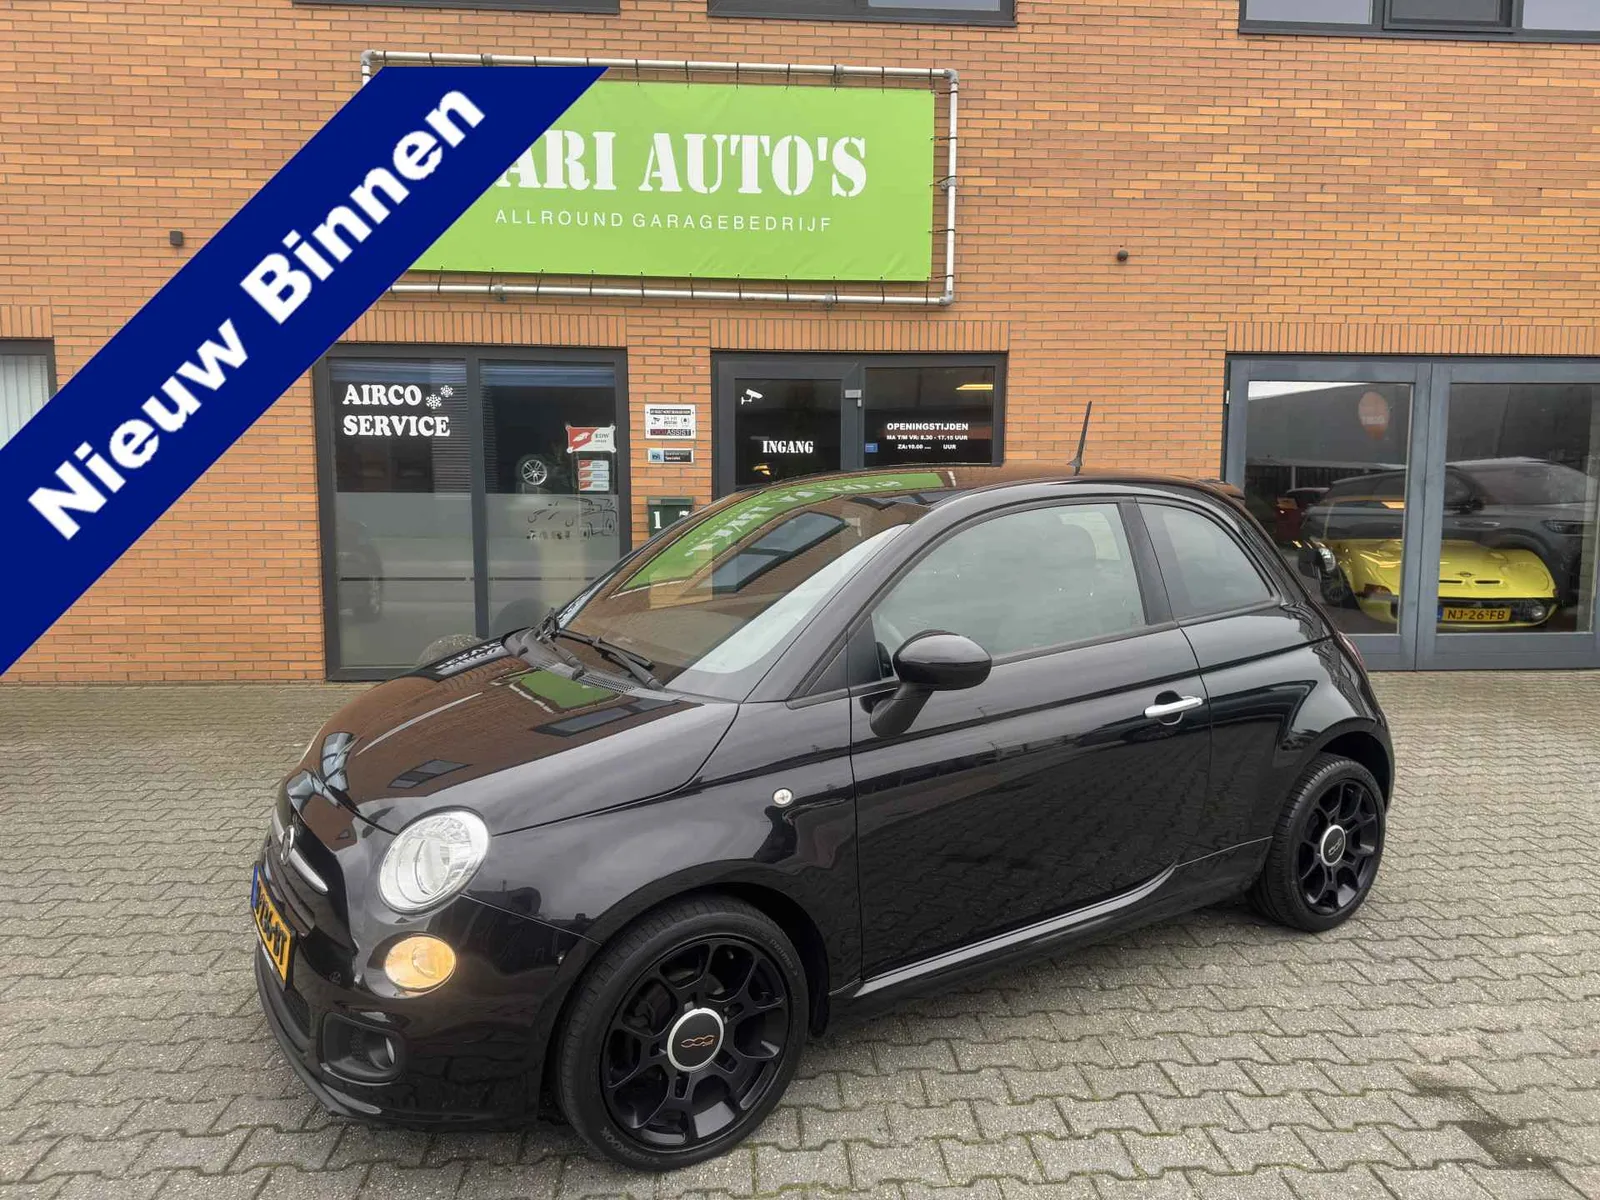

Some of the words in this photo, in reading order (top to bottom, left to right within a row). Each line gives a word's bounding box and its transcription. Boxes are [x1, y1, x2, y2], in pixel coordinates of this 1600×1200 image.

[638, 132, 867, 198] AUTO'S
[495, 209, 623, 228] ALLROUND
[632, 213, 832, 232] GARAGEBEDRIJF
[342, 383, 422, 406] AIRCO
[343, 414, 451, 437] SERVICE
[886, 422, 969, 431] OPENINGSTIJDEN
[762, 440, 814, 454] INGANG
